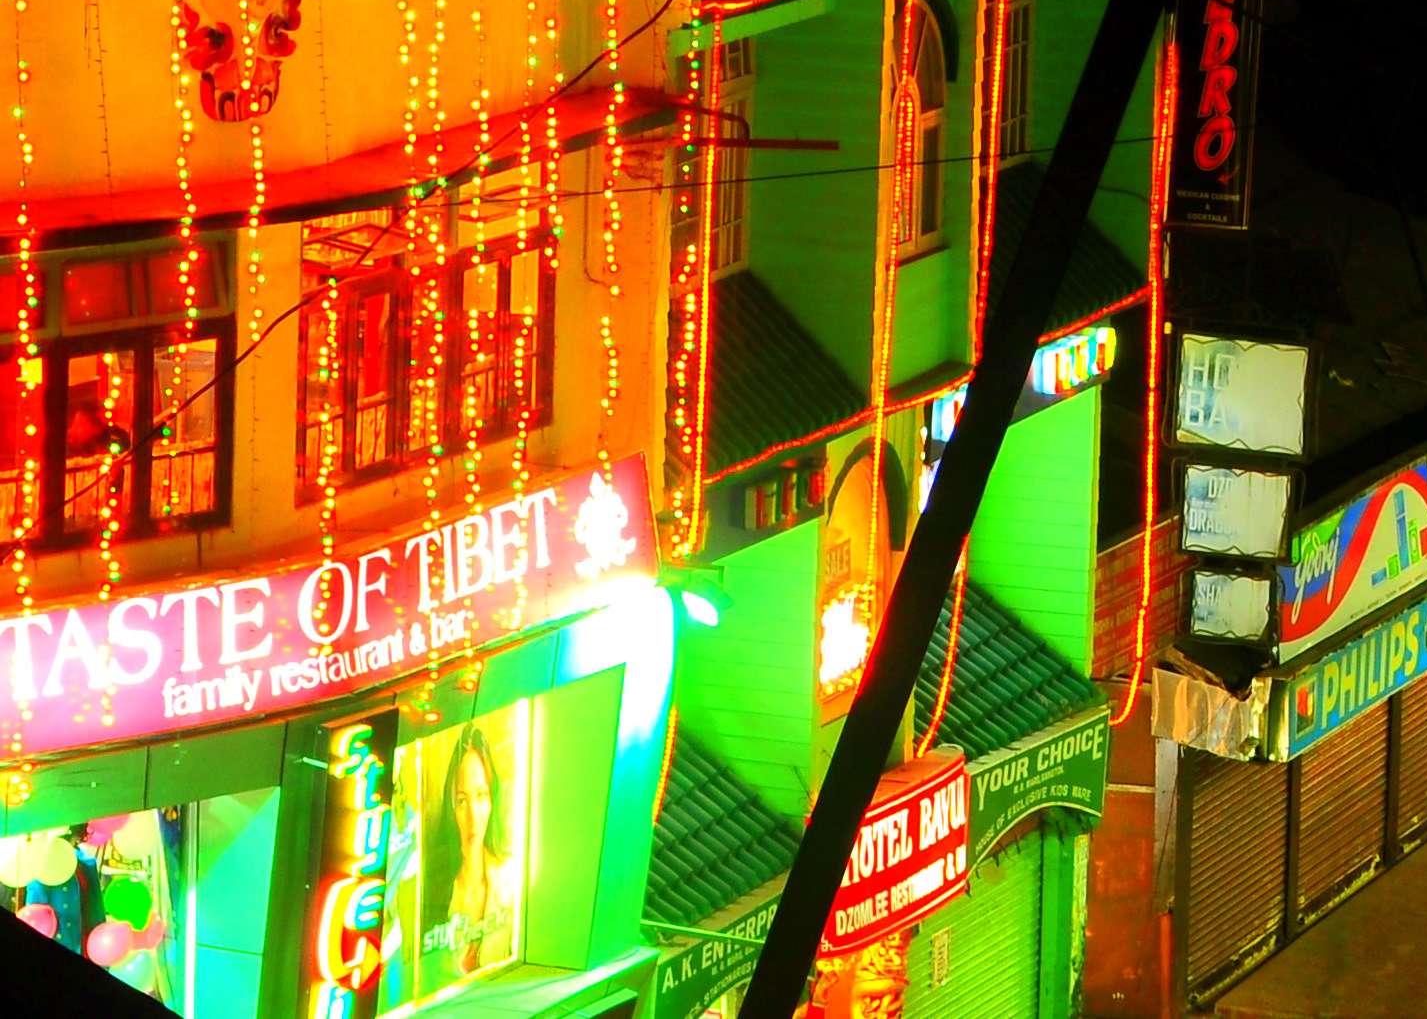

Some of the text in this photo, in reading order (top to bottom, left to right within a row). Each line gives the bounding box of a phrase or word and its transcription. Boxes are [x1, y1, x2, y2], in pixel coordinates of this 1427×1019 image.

[0, 488, 557, 701] TASTE OF TIBET
[163, 607, 469, 718] family restaurant & bar
[1320, 610, 1421, 730] PHILIPS
[976, 722, 1106, 812] YOUR CHOICE
[840, 807, 914, 888] HOTEL
